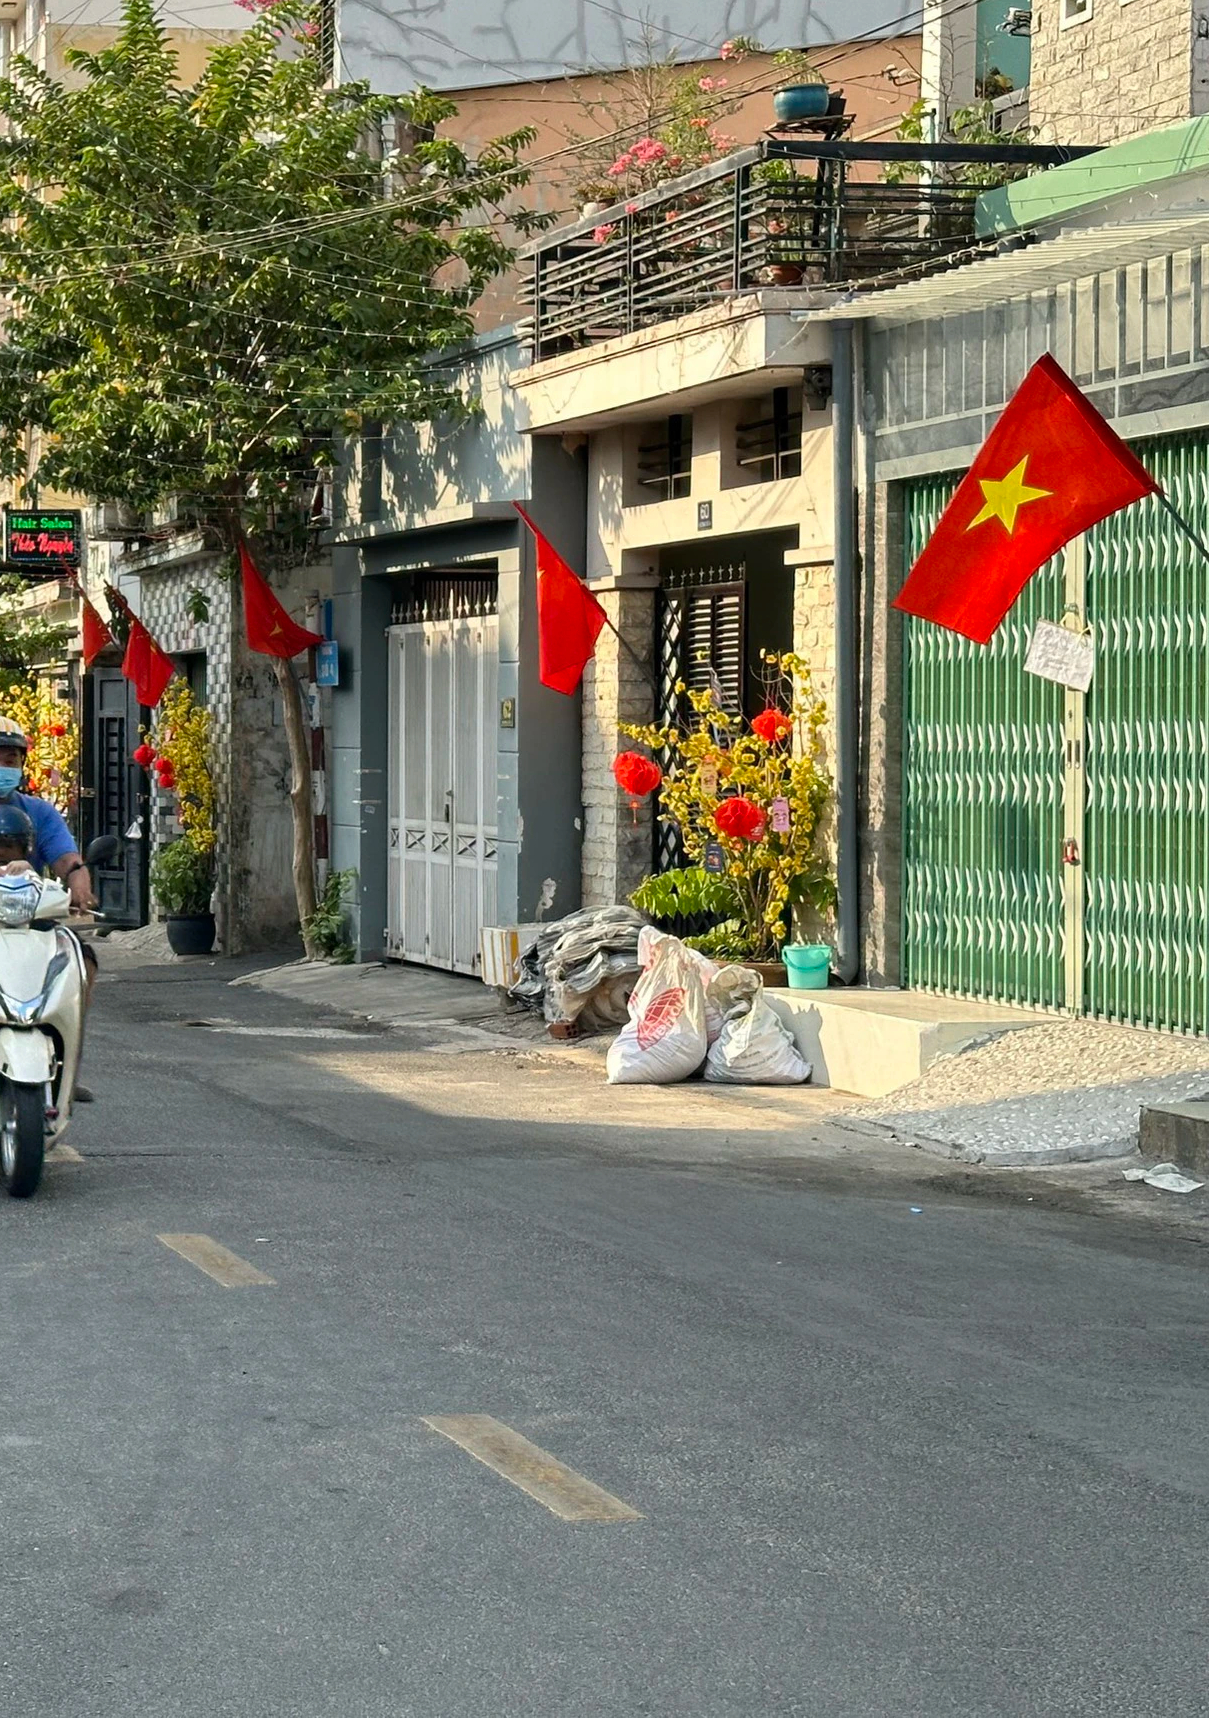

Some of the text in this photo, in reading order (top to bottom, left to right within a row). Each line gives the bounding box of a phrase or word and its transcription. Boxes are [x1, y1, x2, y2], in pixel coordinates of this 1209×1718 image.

[700, 503, 710, 520] 60
[12, 516, 73, 528] Hair Salon
